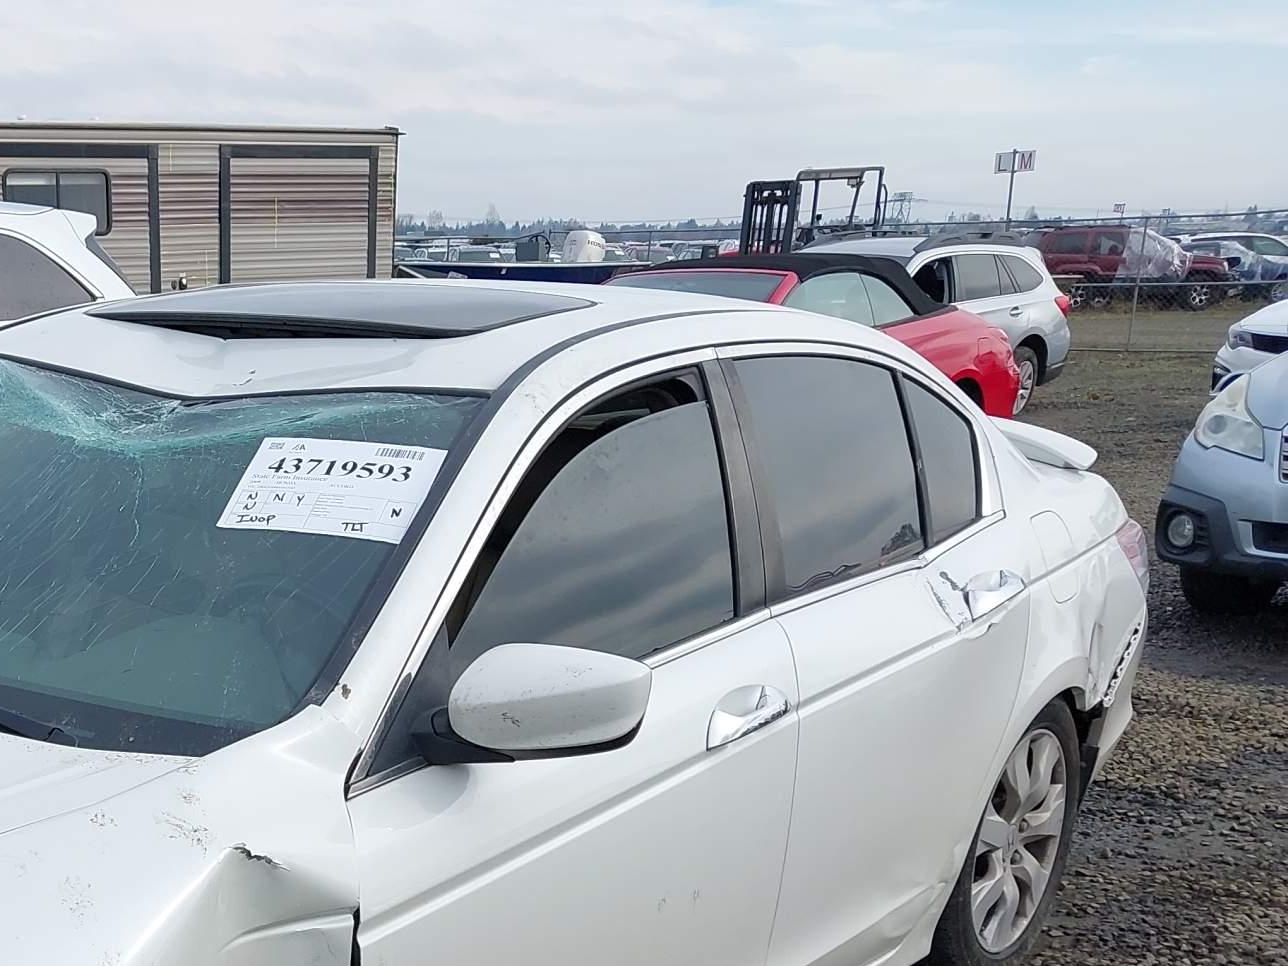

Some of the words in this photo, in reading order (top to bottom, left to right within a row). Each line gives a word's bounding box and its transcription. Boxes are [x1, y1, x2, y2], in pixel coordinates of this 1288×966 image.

[997, 154, 1009, 172] L
[1019, 152, 1033, 170] M
[268, 456, 412, 483] 43719593
